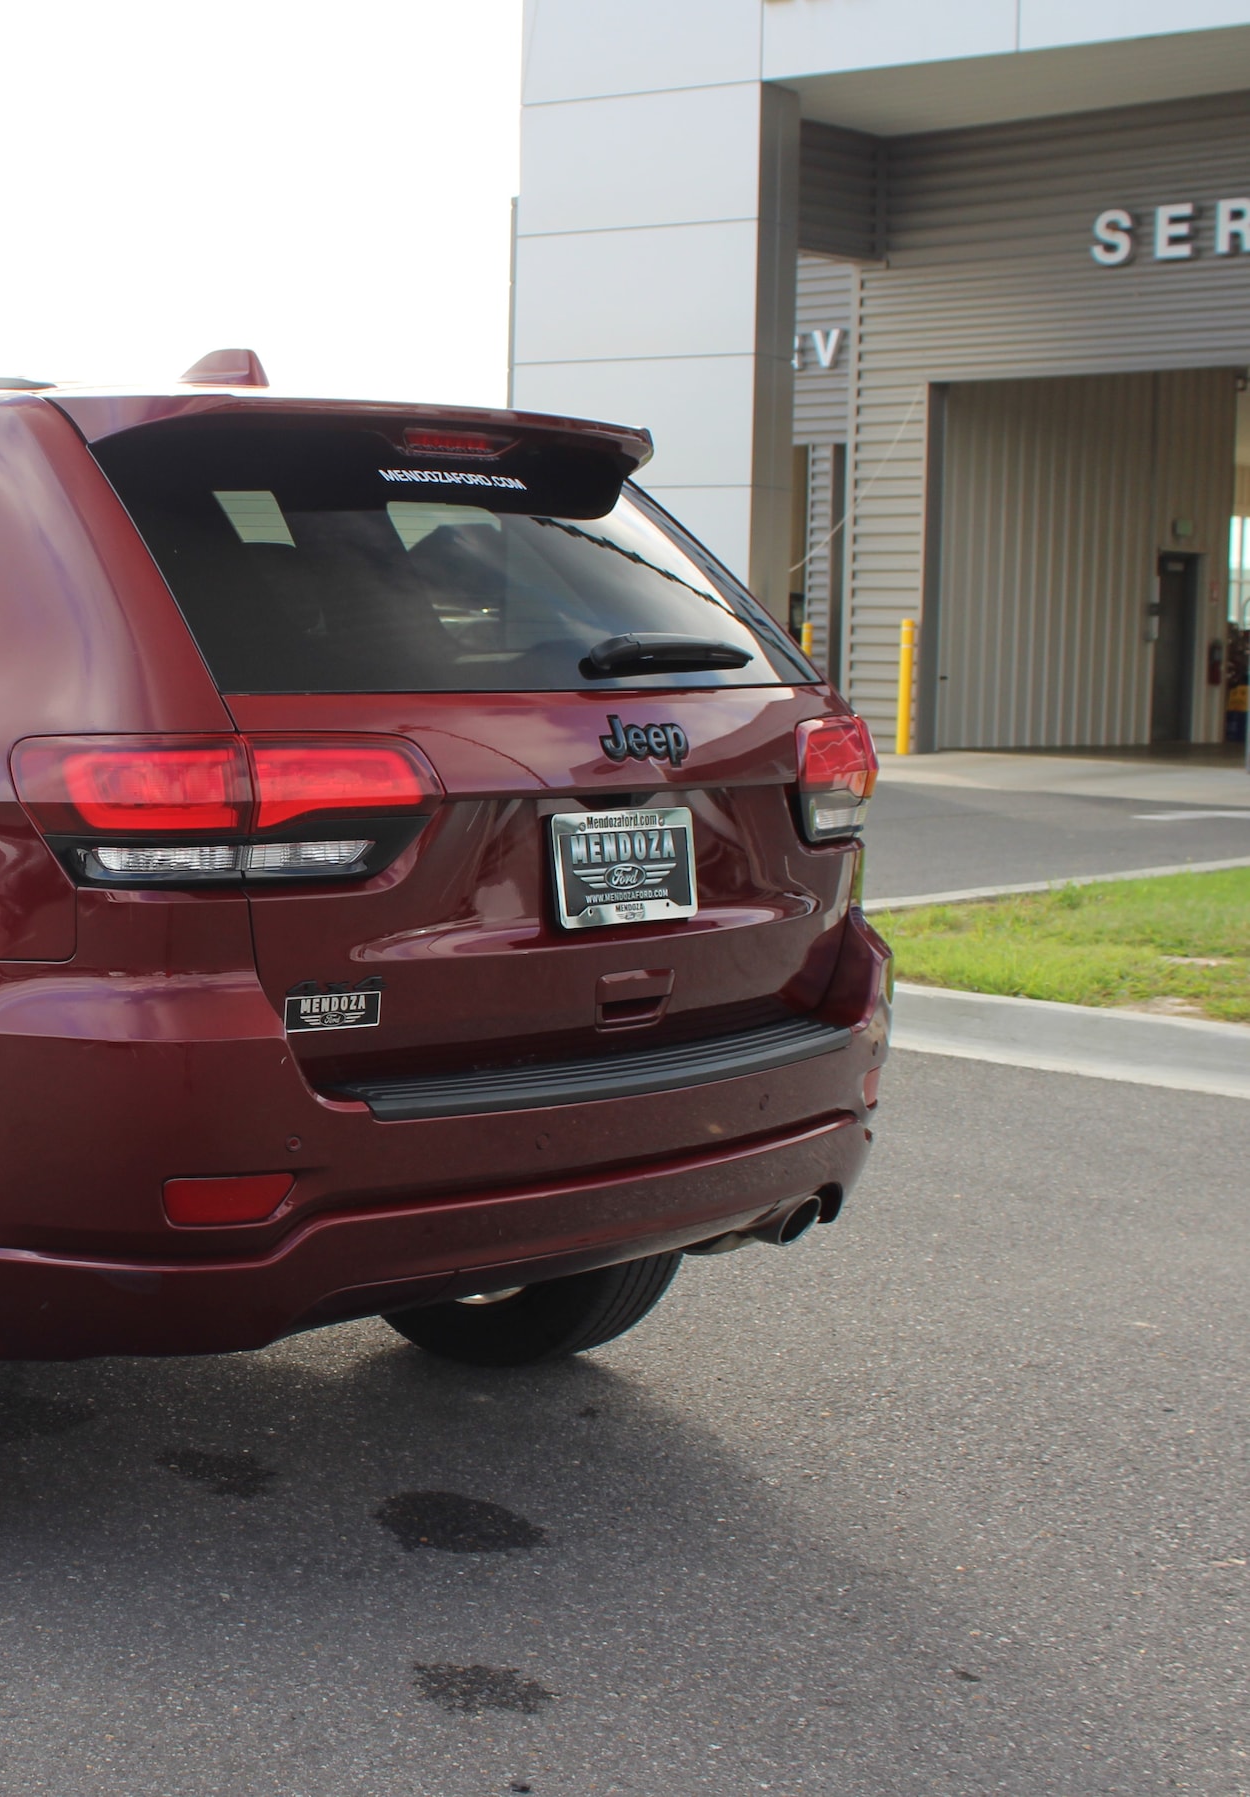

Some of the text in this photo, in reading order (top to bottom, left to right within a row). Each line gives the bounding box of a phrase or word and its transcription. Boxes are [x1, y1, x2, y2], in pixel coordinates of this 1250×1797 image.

[1090, 196, 1250, 268] SER
[378, 468, 528, 491] MENDOZAFORD.COM
[598, 714, 690, 769] Jeep
[586, 813, 657, 830] Mendozaford.com
[570, 829, 677, 865] MENDOZA
[611, 867, 639, 886] Ford
[585, 888, 668, 904] WWW.MENDOZAFORD.COM
[615, 902, 644, 913] MENDOZA
[300, 994, 366, 1014] MENDOZA
[323, 1014, 342, 1024] Ford
